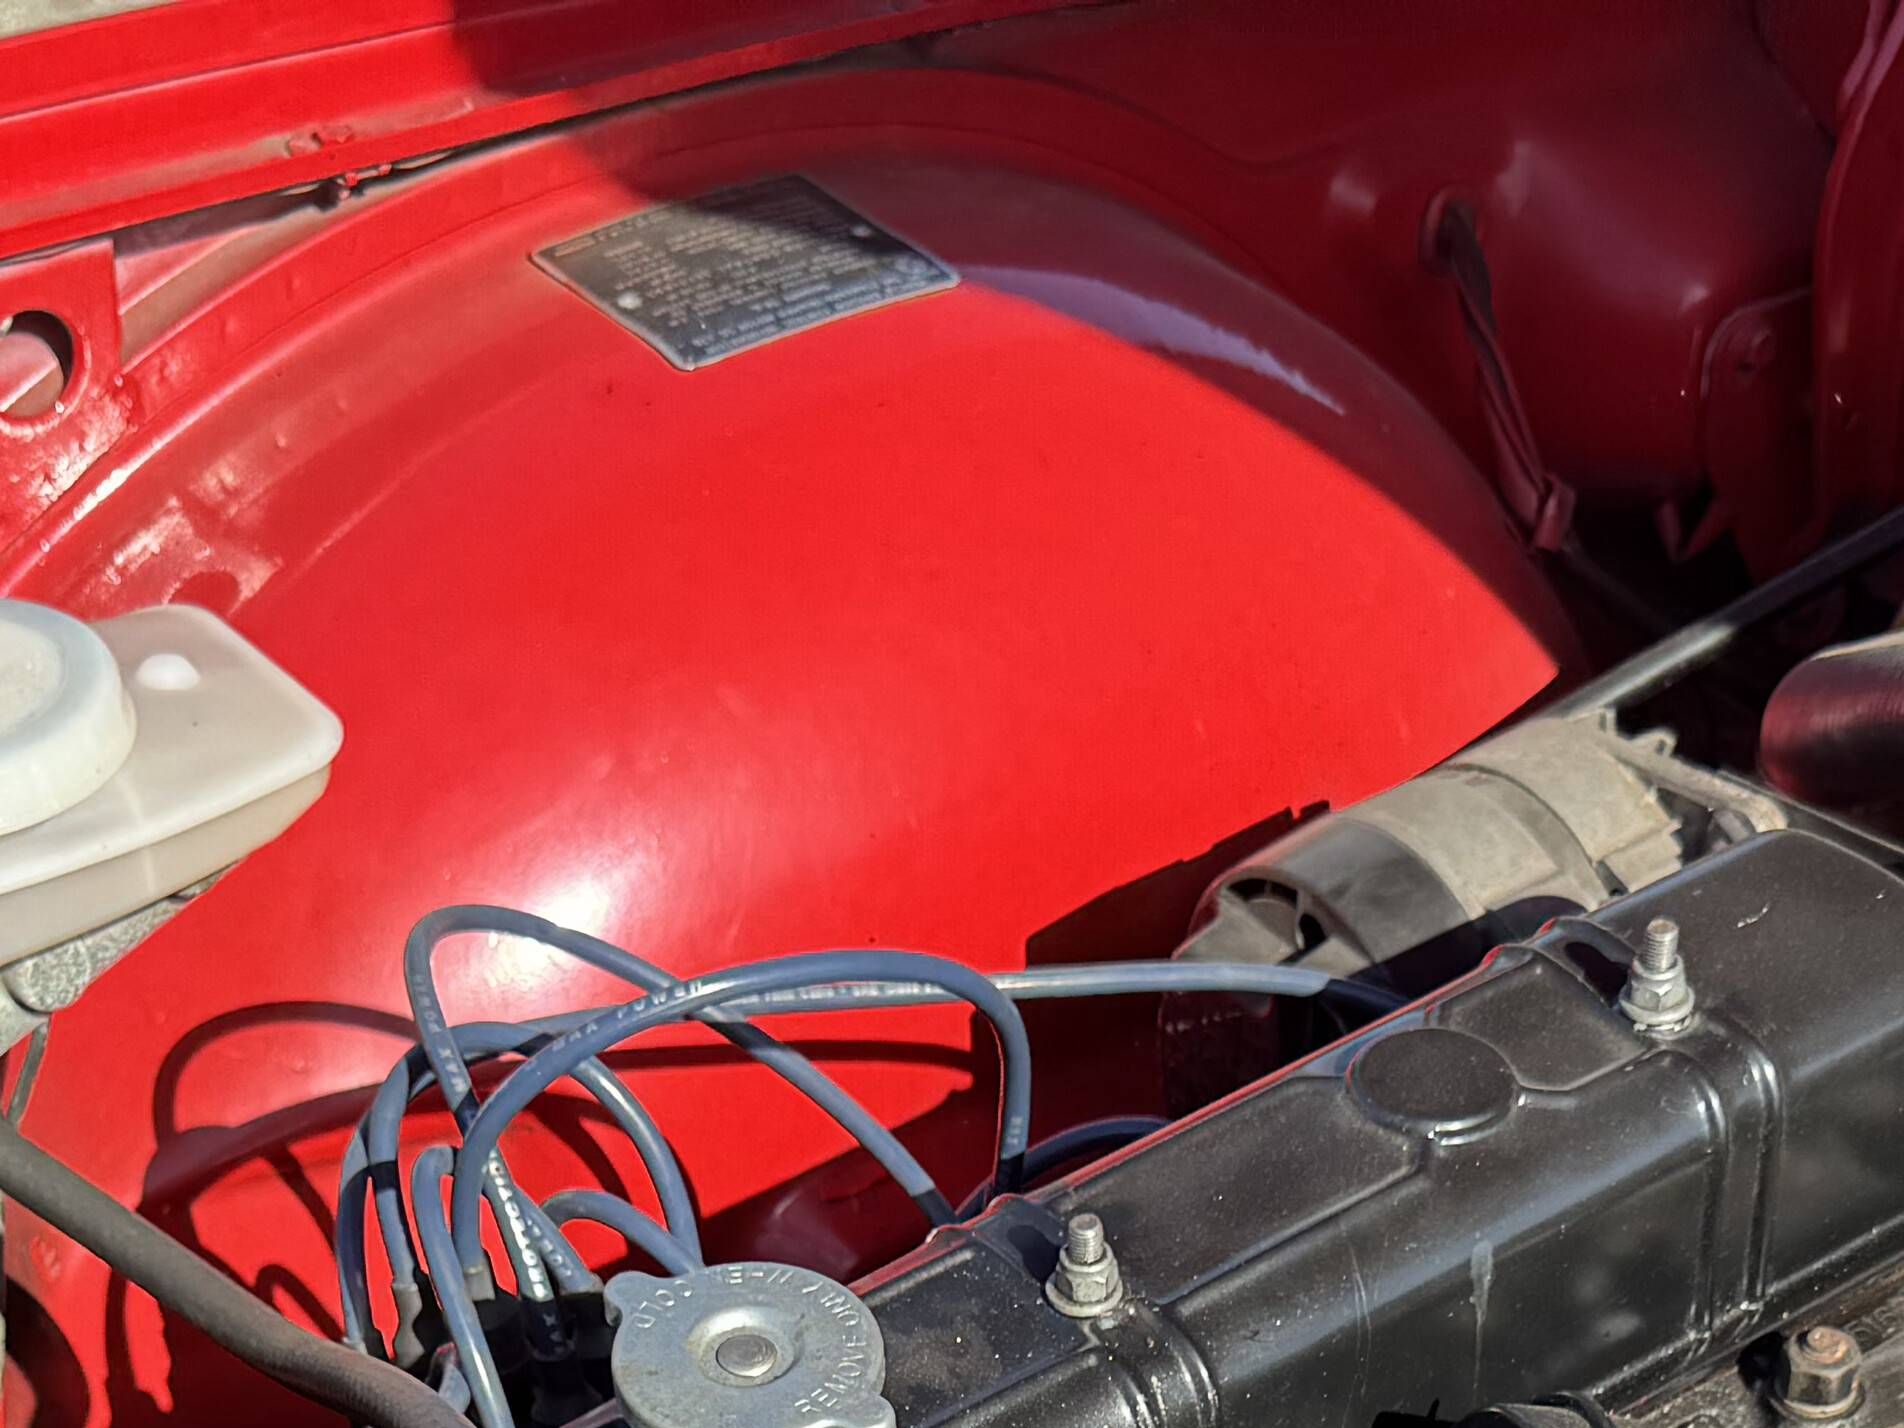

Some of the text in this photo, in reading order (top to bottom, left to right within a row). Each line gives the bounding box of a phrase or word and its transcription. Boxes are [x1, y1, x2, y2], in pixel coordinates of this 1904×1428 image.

[632, 1279, 694, 1329] COLD
[801, 1280, 861, 1327] ONLY
[794, 1334, 867, 1414] REMOVE
